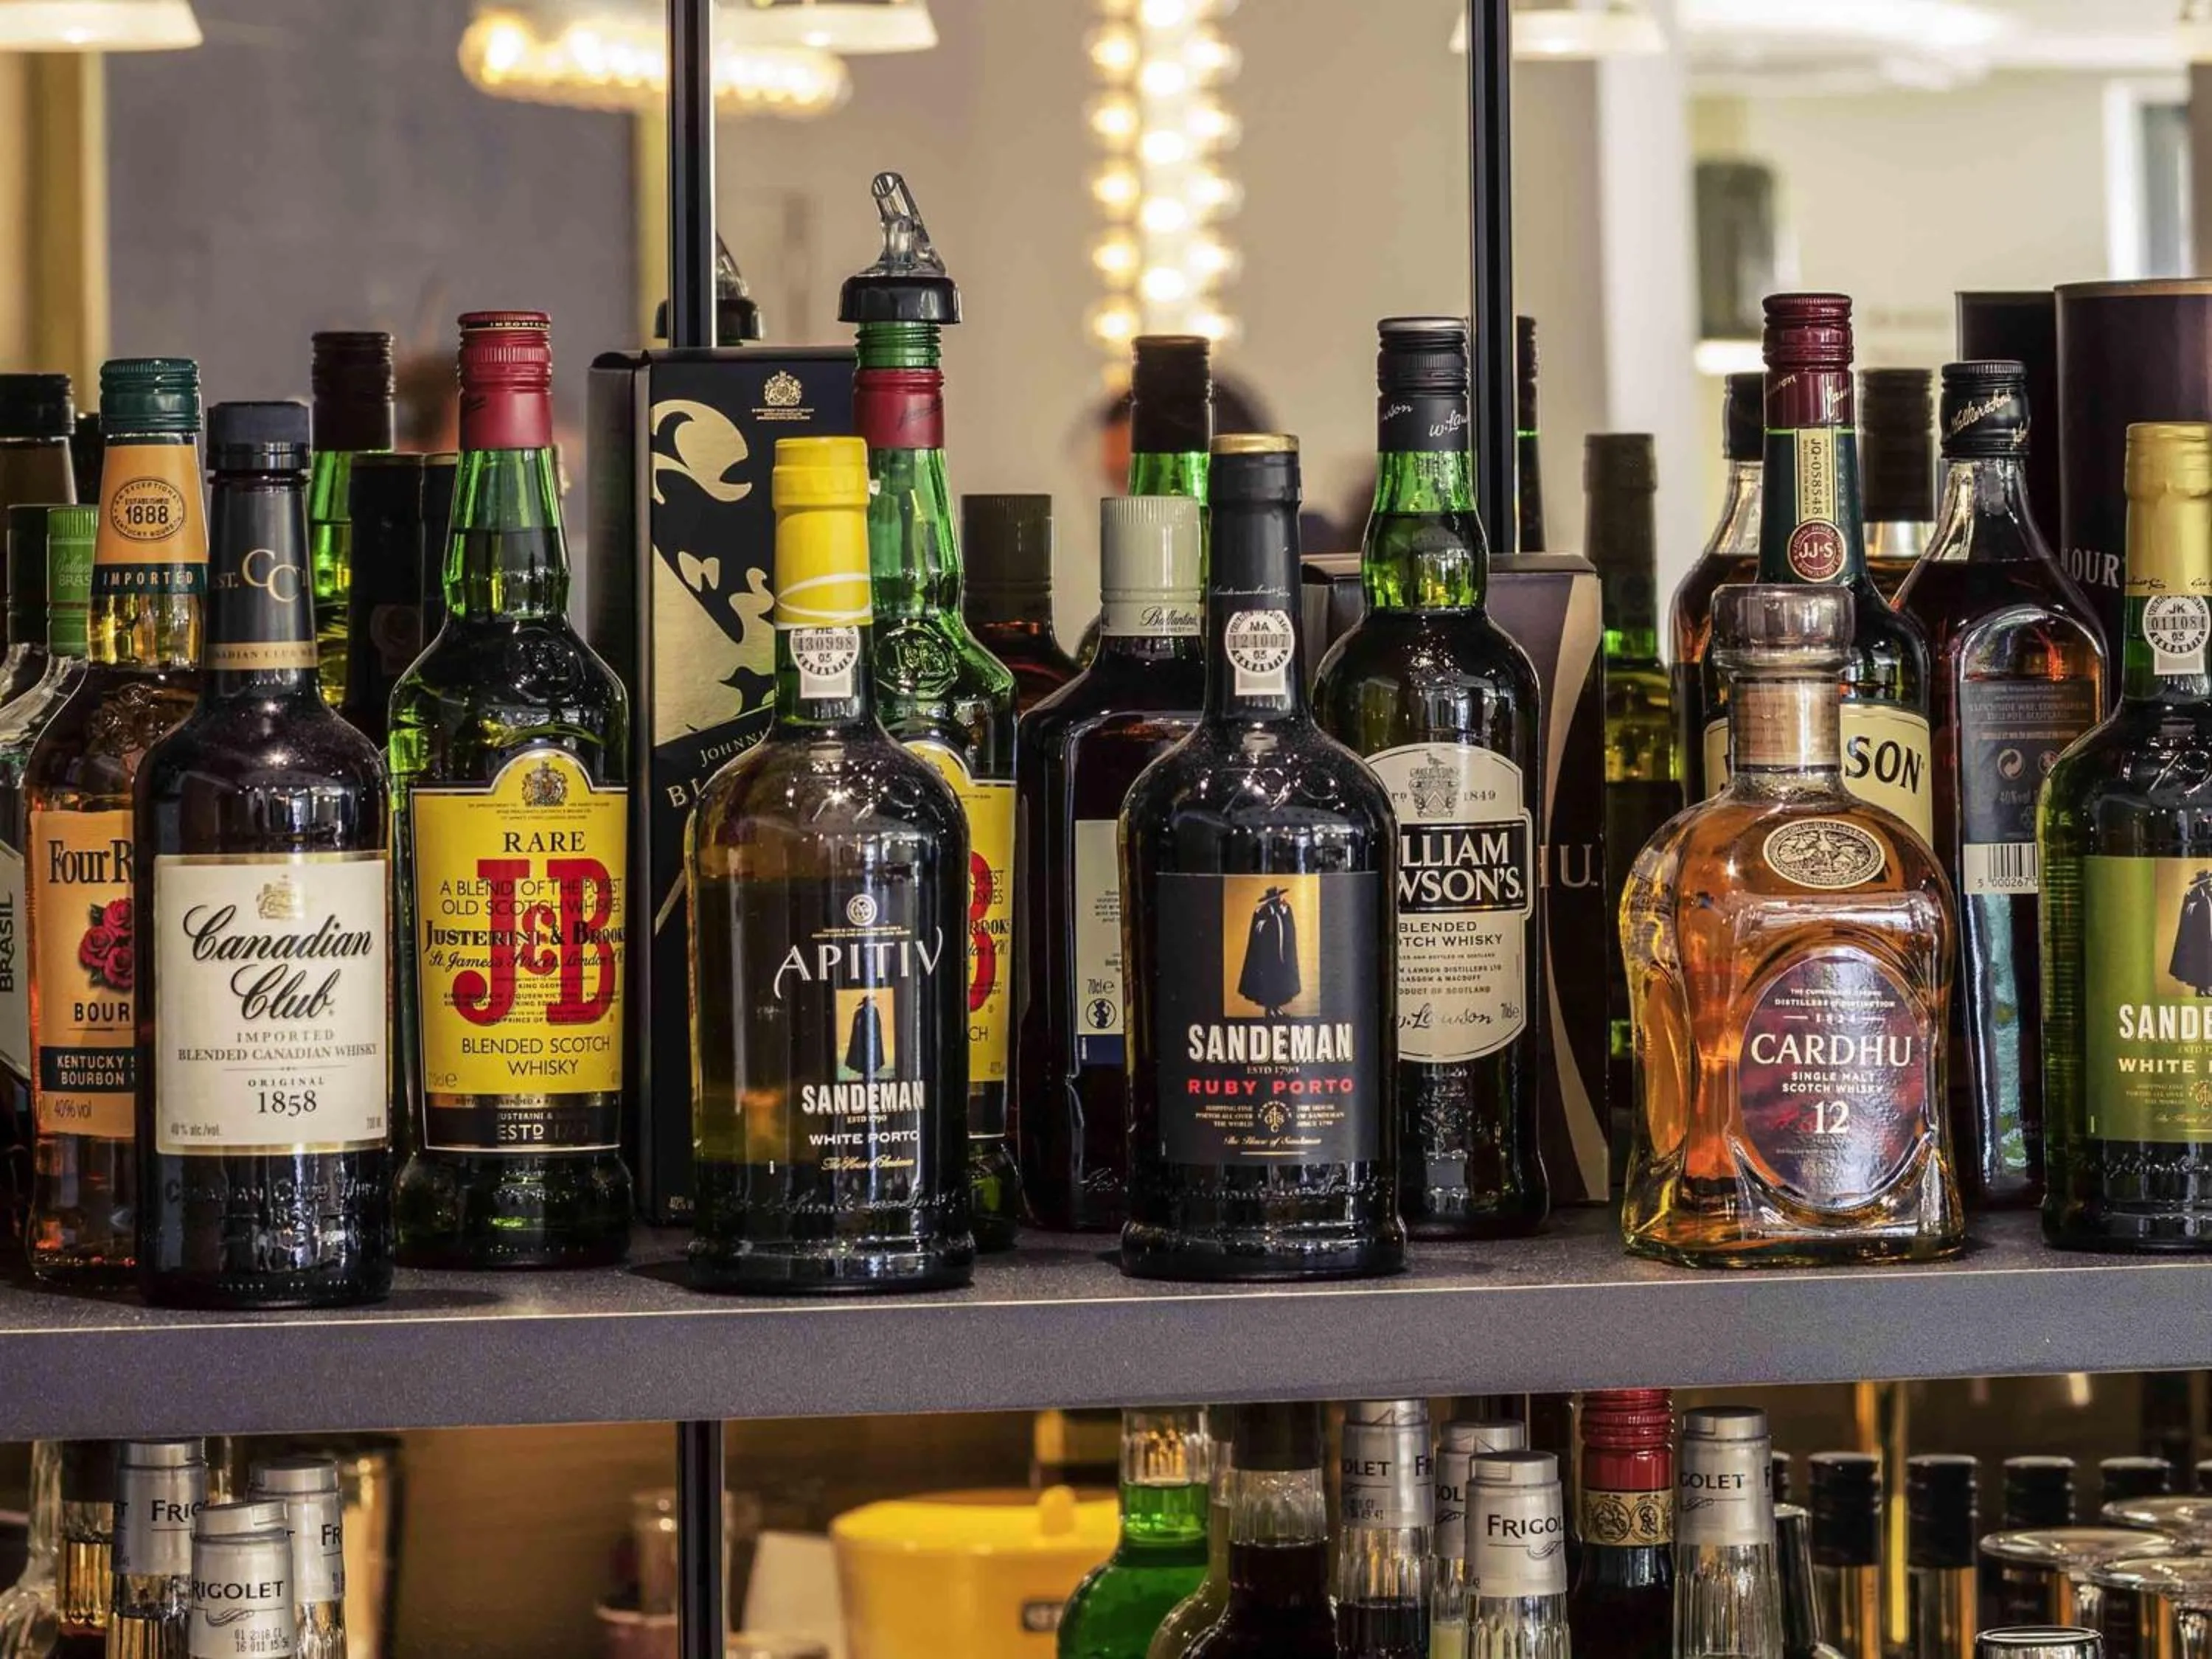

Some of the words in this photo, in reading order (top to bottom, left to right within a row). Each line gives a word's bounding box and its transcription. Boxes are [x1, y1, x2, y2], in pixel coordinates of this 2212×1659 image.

[125, 505, 169, 524] 1888
[103, 571, 194, 586] IMPORTED
[1845, 735, 1921, 794] SON
[1463, 790, 1497, 802] 1849
[504, 831, 586, 853] RARE
[1401, 832, 1509, 867] LLIAM
[48, 839, 111, 885] Four
[439, 880, 452, 896] A
[456, 879, 515, 896] BLEND
[521, 880, 546, 896] OF
[549, 879, 580, 896] THE
[441, 900, 479, 916] OLD
[484, 900, 560, 916] SCOTCH
[182, 903, 374, 962] Canadian
[425, 920, 541, 953] JUSTERINI
[549, 923, 565, 946] &
[1398, 921, 1478, 933] BLENDED
[0, 889, 14, 993] BRASIL
[1399, 936, 1437, 947] TCH
[1441, 933, 1503, 947] WHISKY
[773, 926, 944, 1000] APITIV
[230, 964, 342, 1023] Club
[74, 1002, 131, 1022] BOUR
[236, 1029, 335, 1043] IMPORTED
[462, 1037, 544, 1054] BLENDED
[549, 1034, 611, 1054] SCOTCH
[1187, 1023, 1354, 1064] SANDEMAN
[177, 1048, 249, 1062] BLENDED
[251, 1046, 333, 1061] CANADIAN
[335, 1043, 378, 1058] WHISKY
[1750, 1032, 1912, 1067] CARDHU
[57, 1055, 125, 1068] KENTUCKY
[507, 1058, 580, 1077] WHISKY
[2118, 1057, 2197, 1074] WHITE
[60, 1071, 125, 1086] BOURBON
[247, 1076, 326, 1088] ORIGINAL
[1790, 1071, 1837, 1082] SINGLE
[1841, 1072, 1876, 1082] MALT
[1187, 1079, 1257, 1095] RUBY
[1272, 1078, 1354, 1094] PORTO
[1781, 1083, 1831, 1093] SCOTCH
[1835, 1084, 1884, 1094] WHISKY
[257, 1090, 318, 1118] 1858
[801, 1080, 925, 1115] SANDEMAN
[1813, 1099, 1850, 1134] 12
[496, 1124, 545, 1140] ESTD
[808, 1133, 863, 1146] WHITE
[867, 1130, 921, 1144] PORTO
[191, 1579, 285, 1603] RIGOLET
